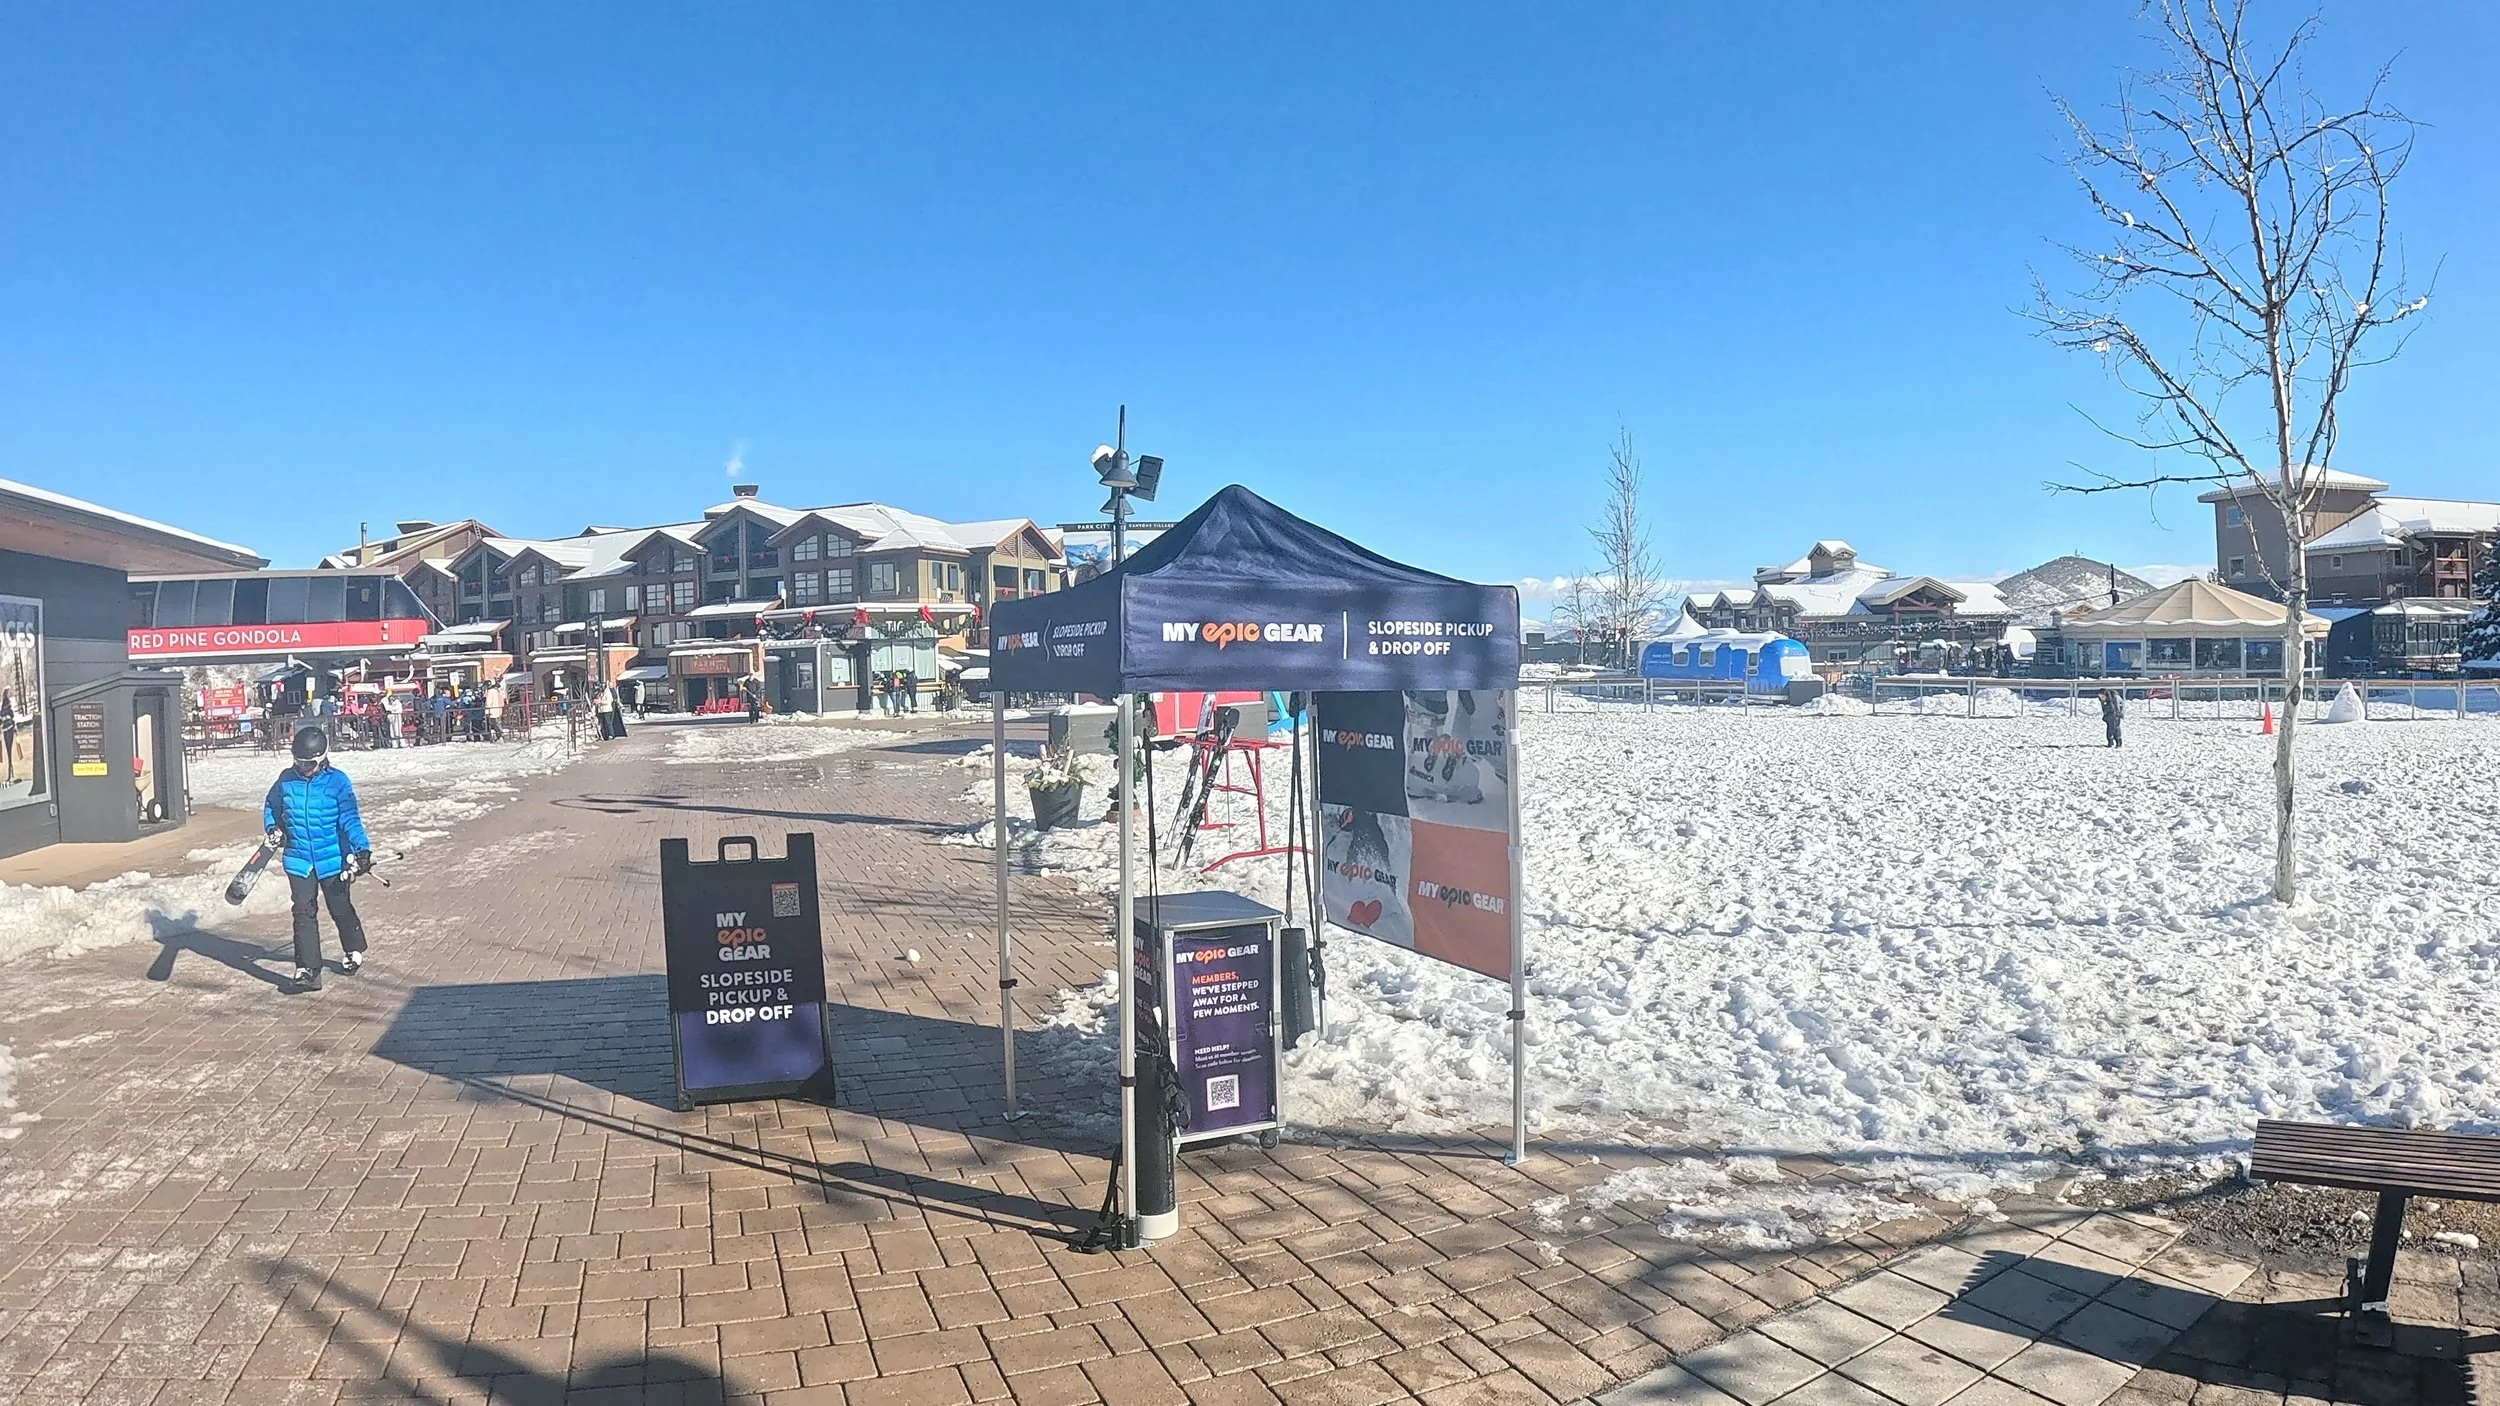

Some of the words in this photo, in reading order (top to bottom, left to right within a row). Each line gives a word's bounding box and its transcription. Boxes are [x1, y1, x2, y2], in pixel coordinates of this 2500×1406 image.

[1052, 623, 1084, 639] SLOPESIDE
[1084, 620, 1108, 637] PICKUP
[1162, 622, 1200, 642] MY
[1201, 622, 1261, 651] epic
[1263, 622, 1325, 643] GEAR
[1368, 621, 1443, 636] SLOPESIDE
[1445, 622, 1494, 637] PICKUP
[130, 634, 164, 649] RED
[169, 632, 208, 648] PINE
[213, 629, 302, 646] GONDOLA
[1368, 640, 1379, 655] &
[1382, 641, 1421, 655] DROP
[1423, 641, 1451, 656] OFF
[1073, 642, 1086, 657] OFF
[1322, 729, 1338, 743] MY
[1365, 733, 1395, 750] GEAR
[1413, 737, 1433, 753] MY
[1466, 739, 1503, 756] GEAR
[1418, 880, 1440, 899] MY
[1440, 885, 1472, 909] epic
[1472, 892, 1505, 915] GEAR
[716, 912, 747, 928] MY
[717, 927, 767, 950] epic
[719, 944, 771, 961] GEAR
[1176, 951, 1195, 964] MY
[1195, 948, 1227, 965] epic
[1227, 944, 1260, 958] GEAR
[700, 969, 793, 988] SLOPESIDE
[1192, 971, 1239, 985] MEMBERS,
[1192, 984, 1221, 996] WE'VE
[1221, 979, 1259, 993] STEPPED
[709, 988, 772, 1006] PICKUP
[776, 987, 789, 1001] &
[1192, 996, 1219, 1008] AWAY
[1219, 993, 1239, 1004] FOR
[1240, 992, 1248, 1001] A
[706, 1007, 756, 1025] DROP
[759, 1004, 794, 1021] OFF
[1193, 1008, 1213, 1019] FEW
[1213, 1001, 1260, 1016] MOMENTS.
[1194, 1046, 1211, 1055] NEED
